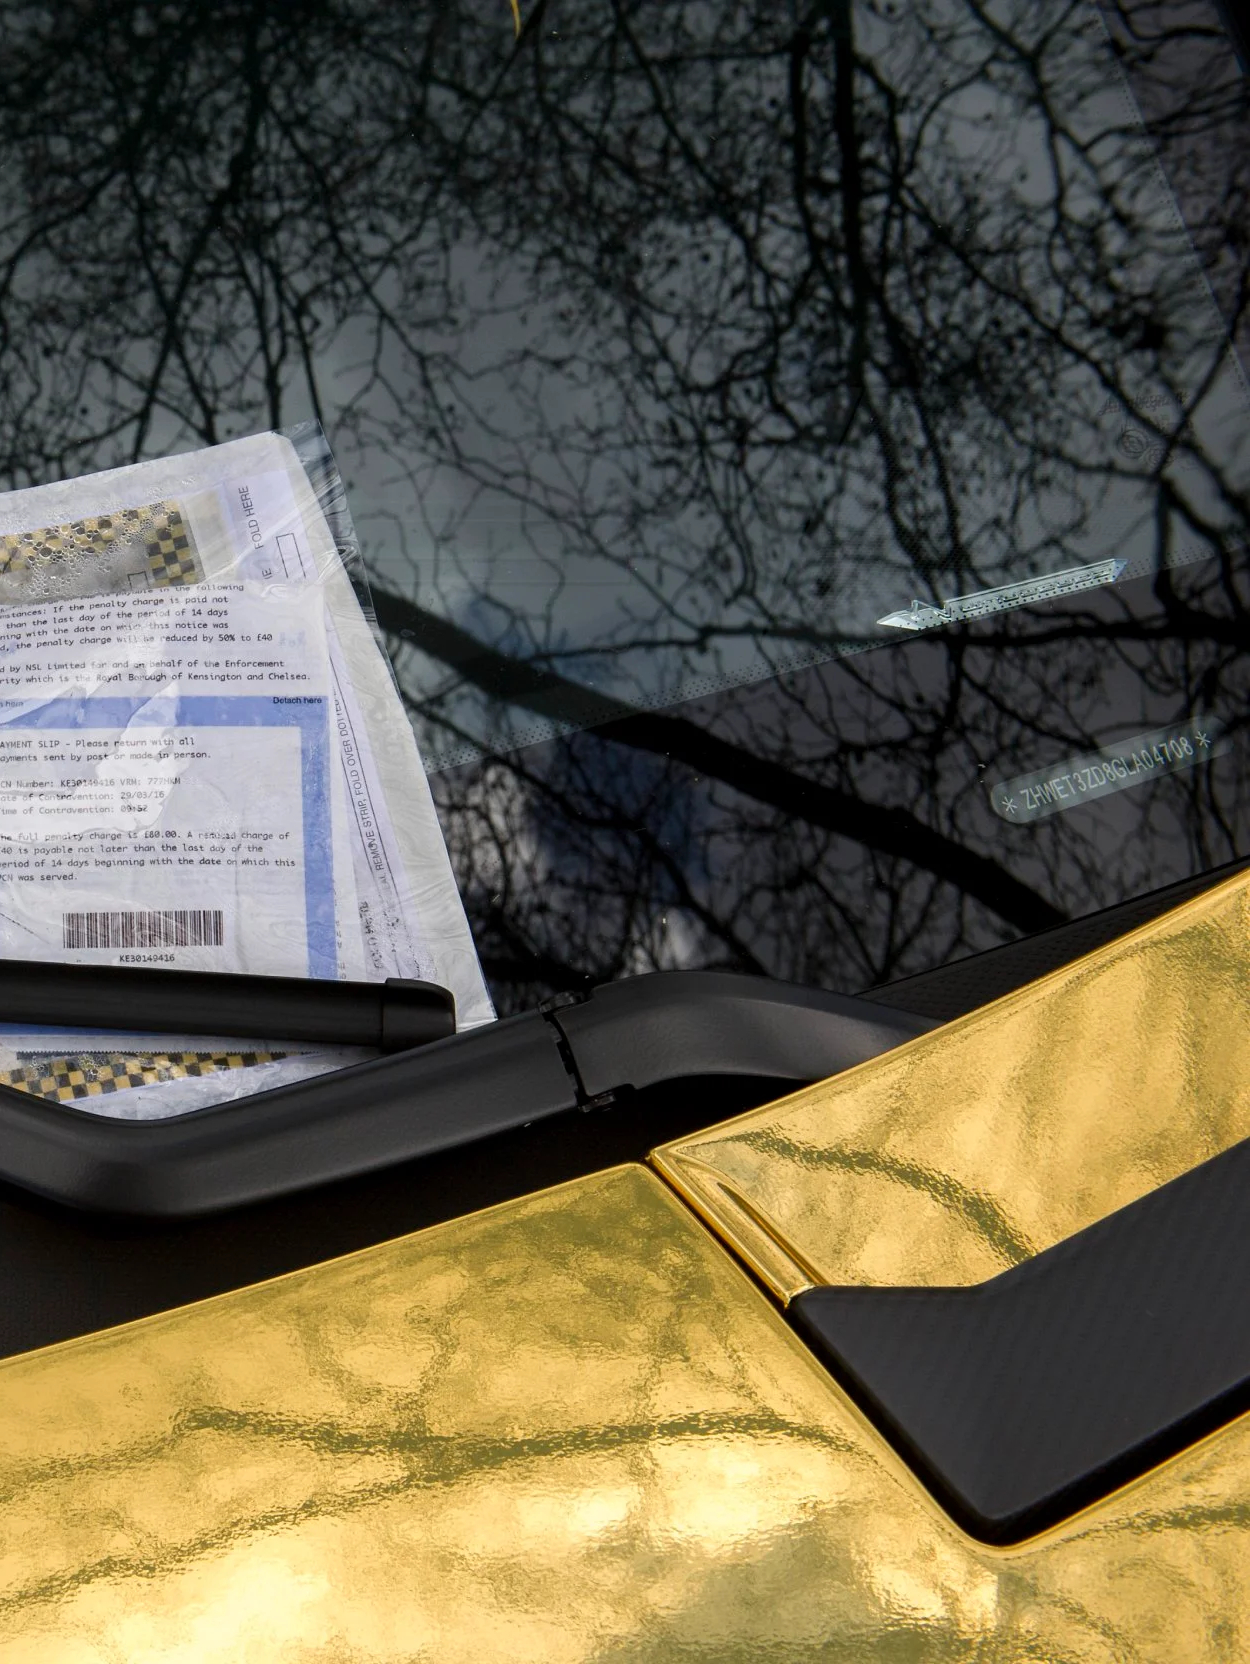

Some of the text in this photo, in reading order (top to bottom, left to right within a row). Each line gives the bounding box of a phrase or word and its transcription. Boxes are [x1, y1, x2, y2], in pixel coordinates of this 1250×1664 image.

[238, 486, 264, 550] FOLD HERE
[53, 616, 74, 624] last
[79, 614, 95, 622] day
[137, 609, 170, 619] period
[175, 608, 186, 616] of
[207, 608, 228, 618] days
[48, 662, 86, 670] Limited
[112, 660, 129, 668] and
[150, 659, 182, 667] behalf
[187, 659, 198, 667] of
[225, 659, 284, 667] Enforcement
[25, 675, 53, 683] which
[97, 673, 122, 683] Royal
[128, 672, 166, 682] Borough
[171, 672, 183, 680] of
[188, 673, 242, 682] Kensington
[268, 672, 310, 680] Chelsea.
[273, 696, 302, 704] Detach
[38, 740, 60, 748] SLIP
[76, 739, 109, 747] Please
[114, 739, 147, 747] return
[151, 738, 174, 746] with
[179, 737, 194, 745] all
[70, 753, 82, 762] by
[87, 753, 109, 762] post
[113, 752, 125, 760] or
[130, 751, 153, 759] made
[158, 751, 169, 759] in
[342, 739, 356, 766] OVER
[1020, 735, 1194, 809] ZHWET3ZD8GLA04708
[16, 780, 53, 788] Number:
[350, 769, 364, 796] FOLD
[38, 792, 113, 801] Contravention:
[120, 790, 165, 800] 29/03/16
[22, 806, 34, 815] of
[39, 806, 114, 814] Contravention:
[357, 799, 372, 828] STRIP,
[365, 830, 384, 871] REMOVE
[40, 872, 77, 881] served.
[119, 954, 175, 963] KE30149416
